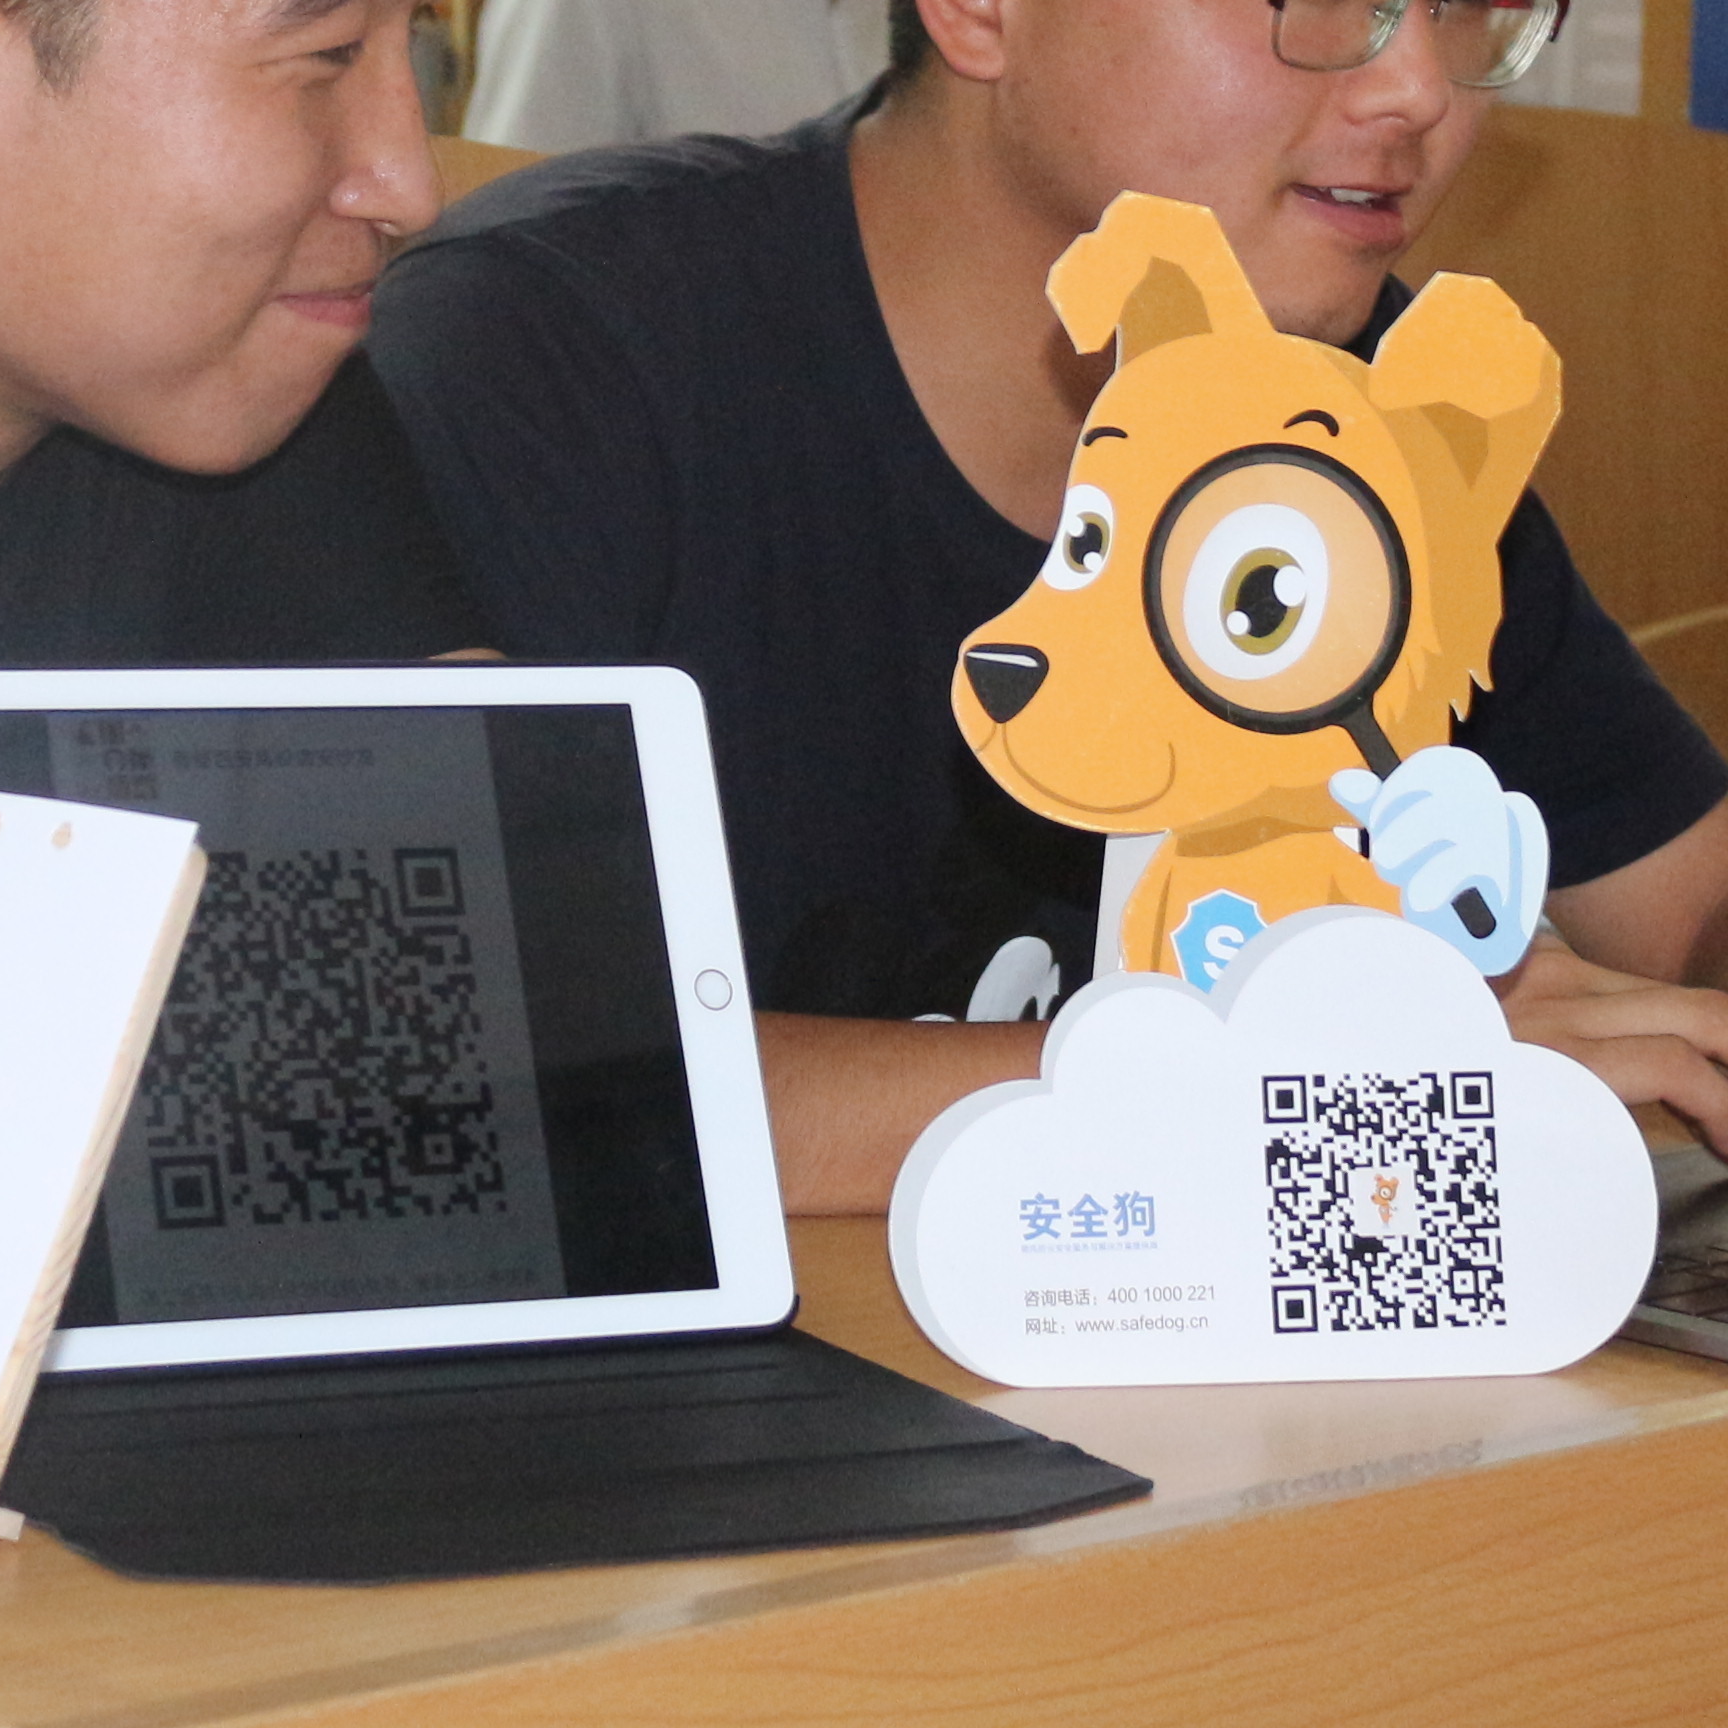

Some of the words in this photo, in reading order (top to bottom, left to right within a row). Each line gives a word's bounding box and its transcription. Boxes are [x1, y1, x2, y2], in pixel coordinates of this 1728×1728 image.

[1203, 924, 1245, 981] S
[1019, 1190, 1156, 1241] 安全狗
[1107, 1287, 1139, 1304] 400
[1144, 1286, 1183, 1303] 1000
[1187, 1284, 1216, 1302] 221
[1075, 1314, 1209, 1333] www.safedog.cn
